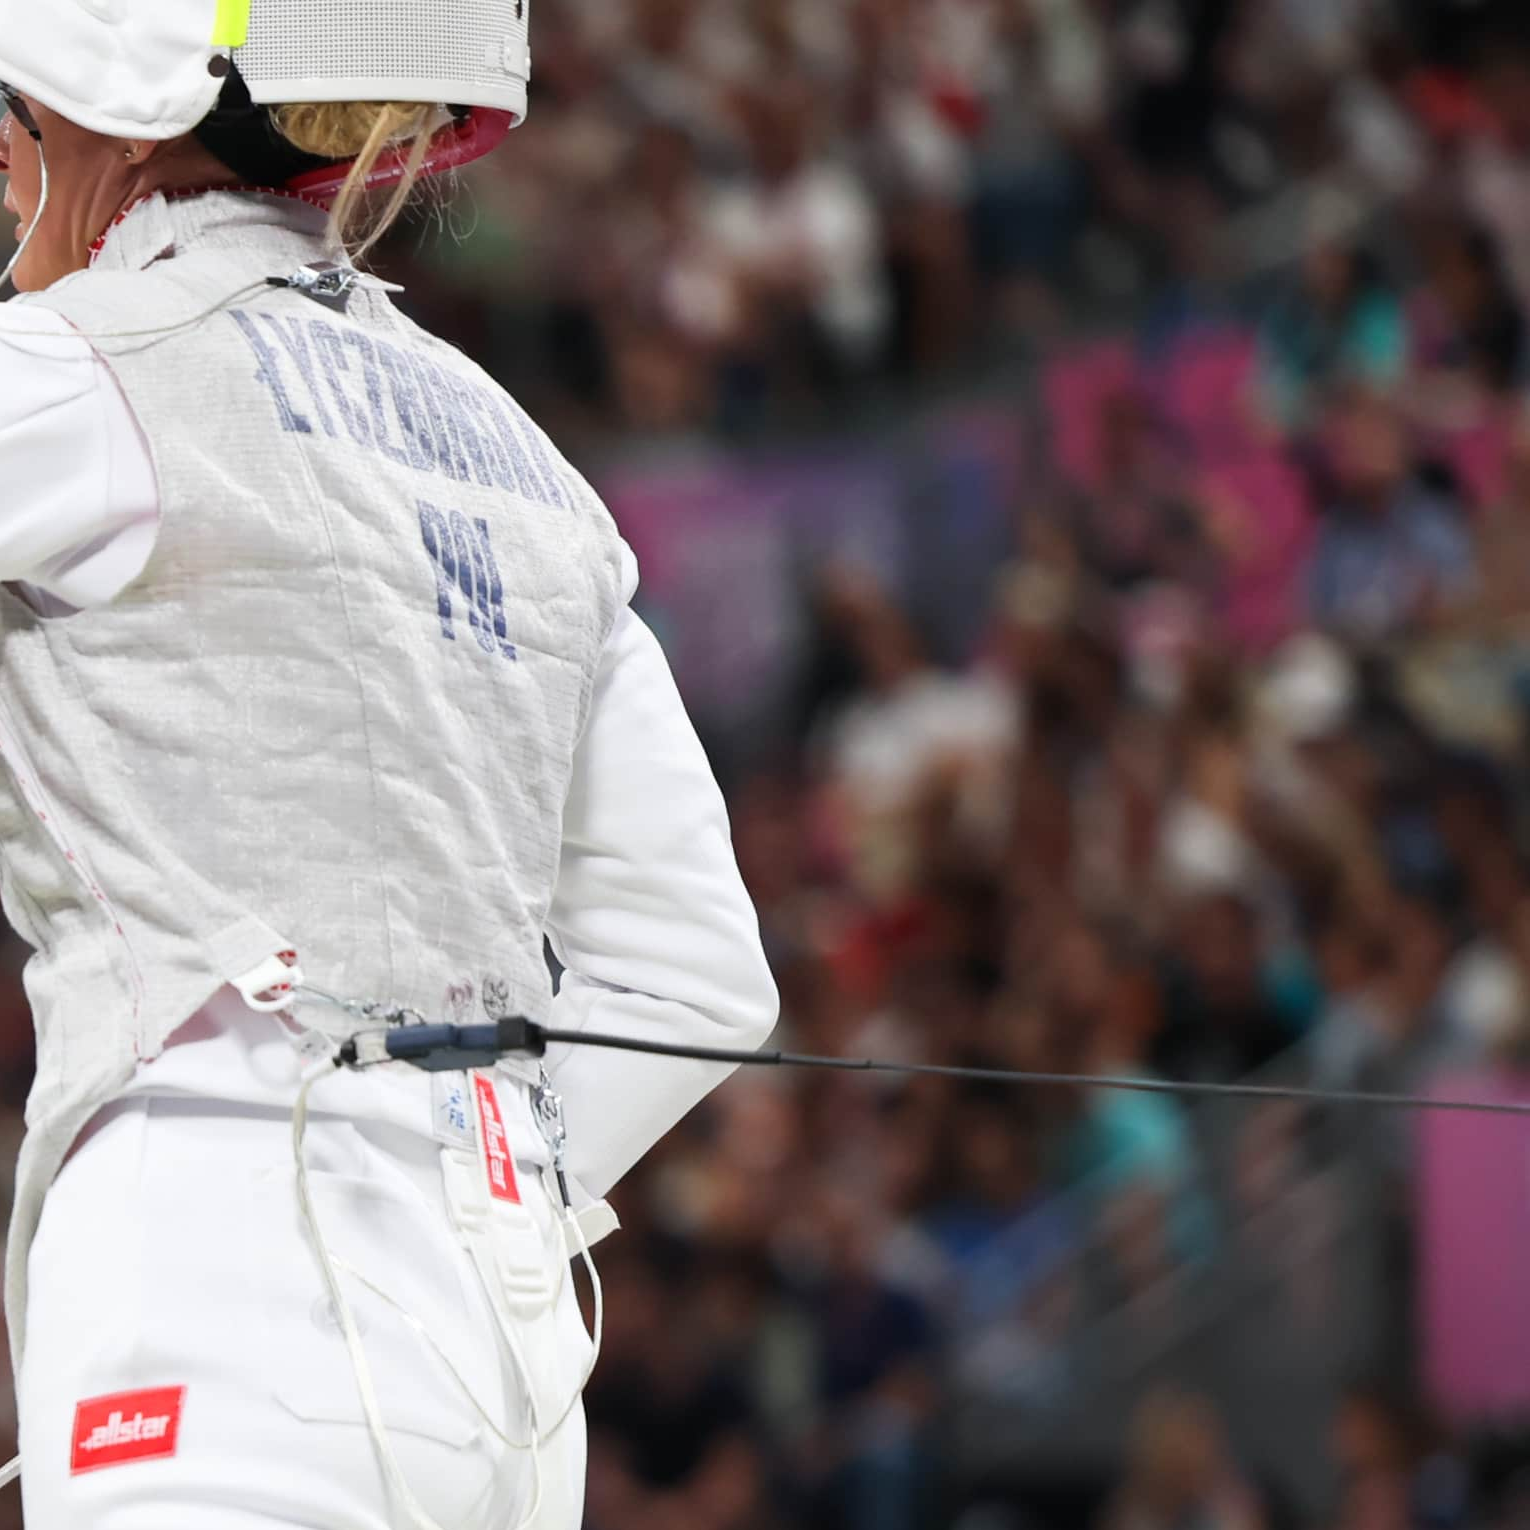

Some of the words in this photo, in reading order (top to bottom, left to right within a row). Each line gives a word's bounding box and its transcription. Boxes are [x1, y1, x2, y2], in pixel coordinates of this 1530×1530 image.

[416, 500, 518, 662] POL
[482, 1092, 507, 1190] allstar
[83, 1411, 171, 1450] allstar
